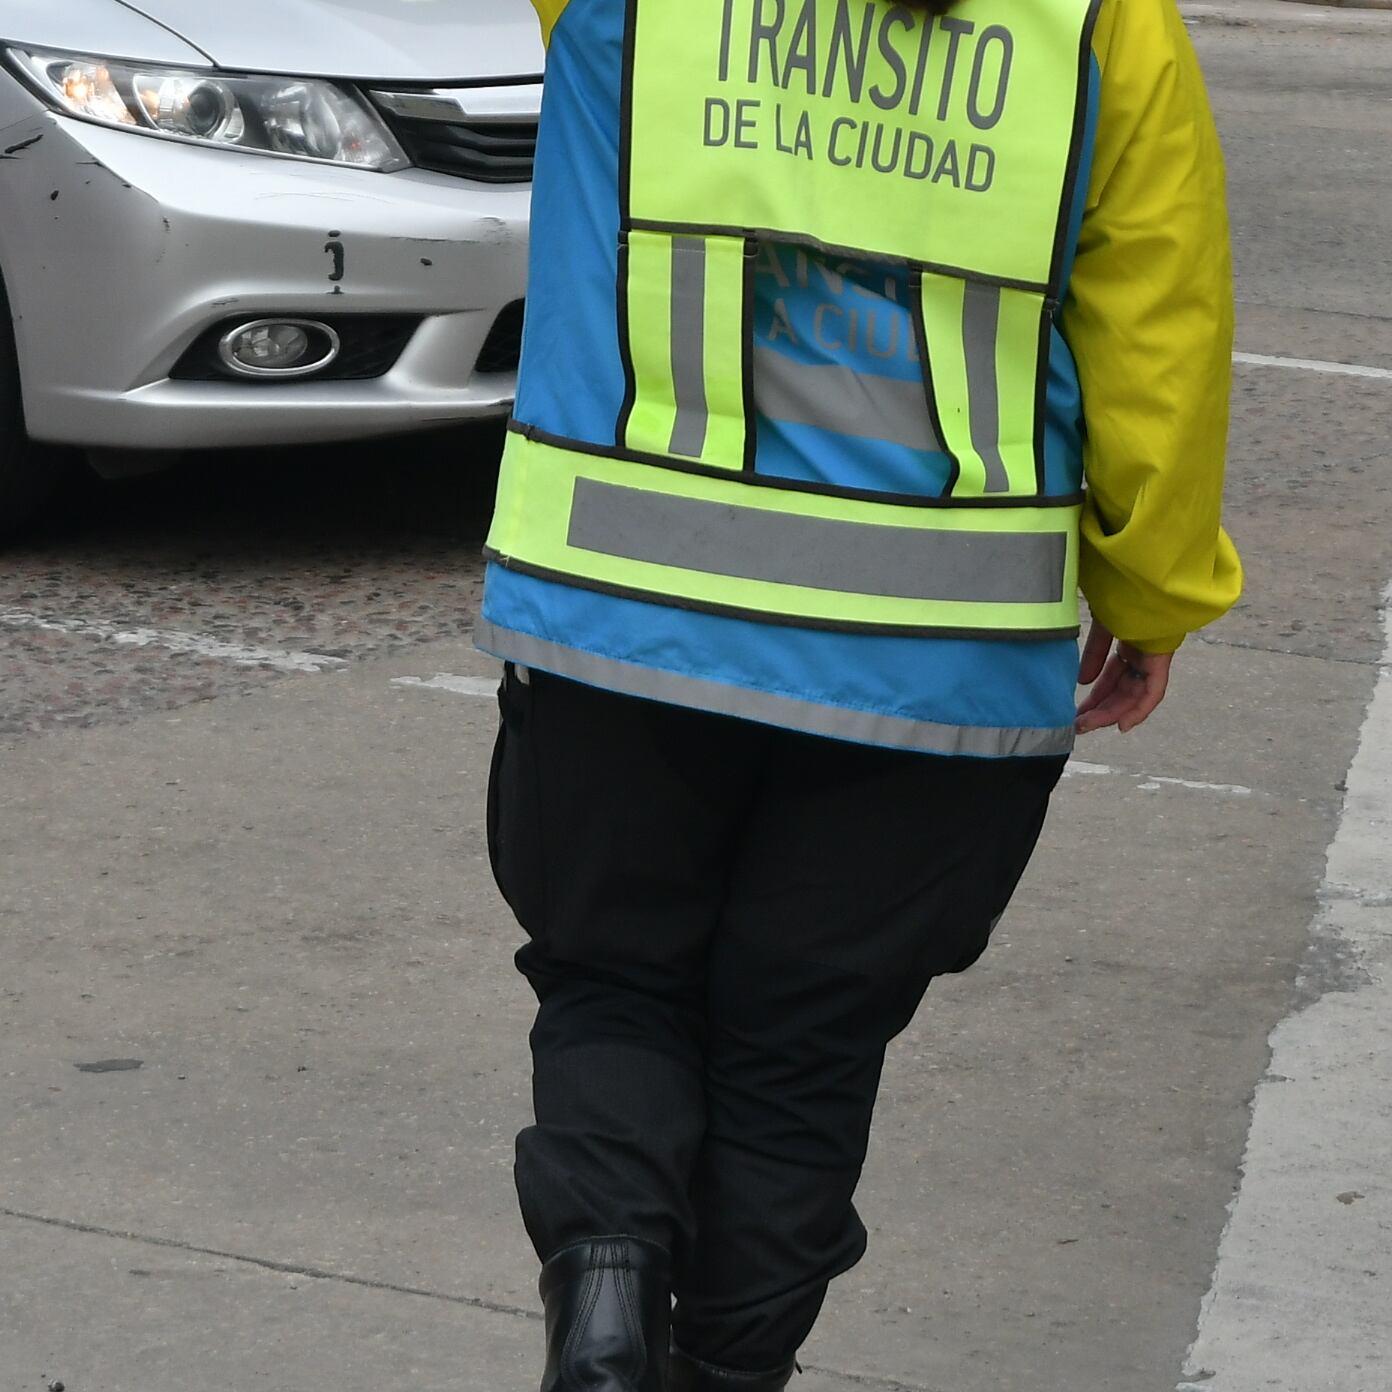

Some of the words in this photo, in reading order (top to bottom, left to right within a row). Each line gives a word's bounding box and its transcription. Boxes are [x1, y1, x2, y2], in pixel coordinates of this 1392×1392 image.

[703, 97, 761, 149] DE
[775, 103, 813, 160] LA
[827, 116, 996, 193] CIUDAD
[813, 303, 920, 361] CIU
